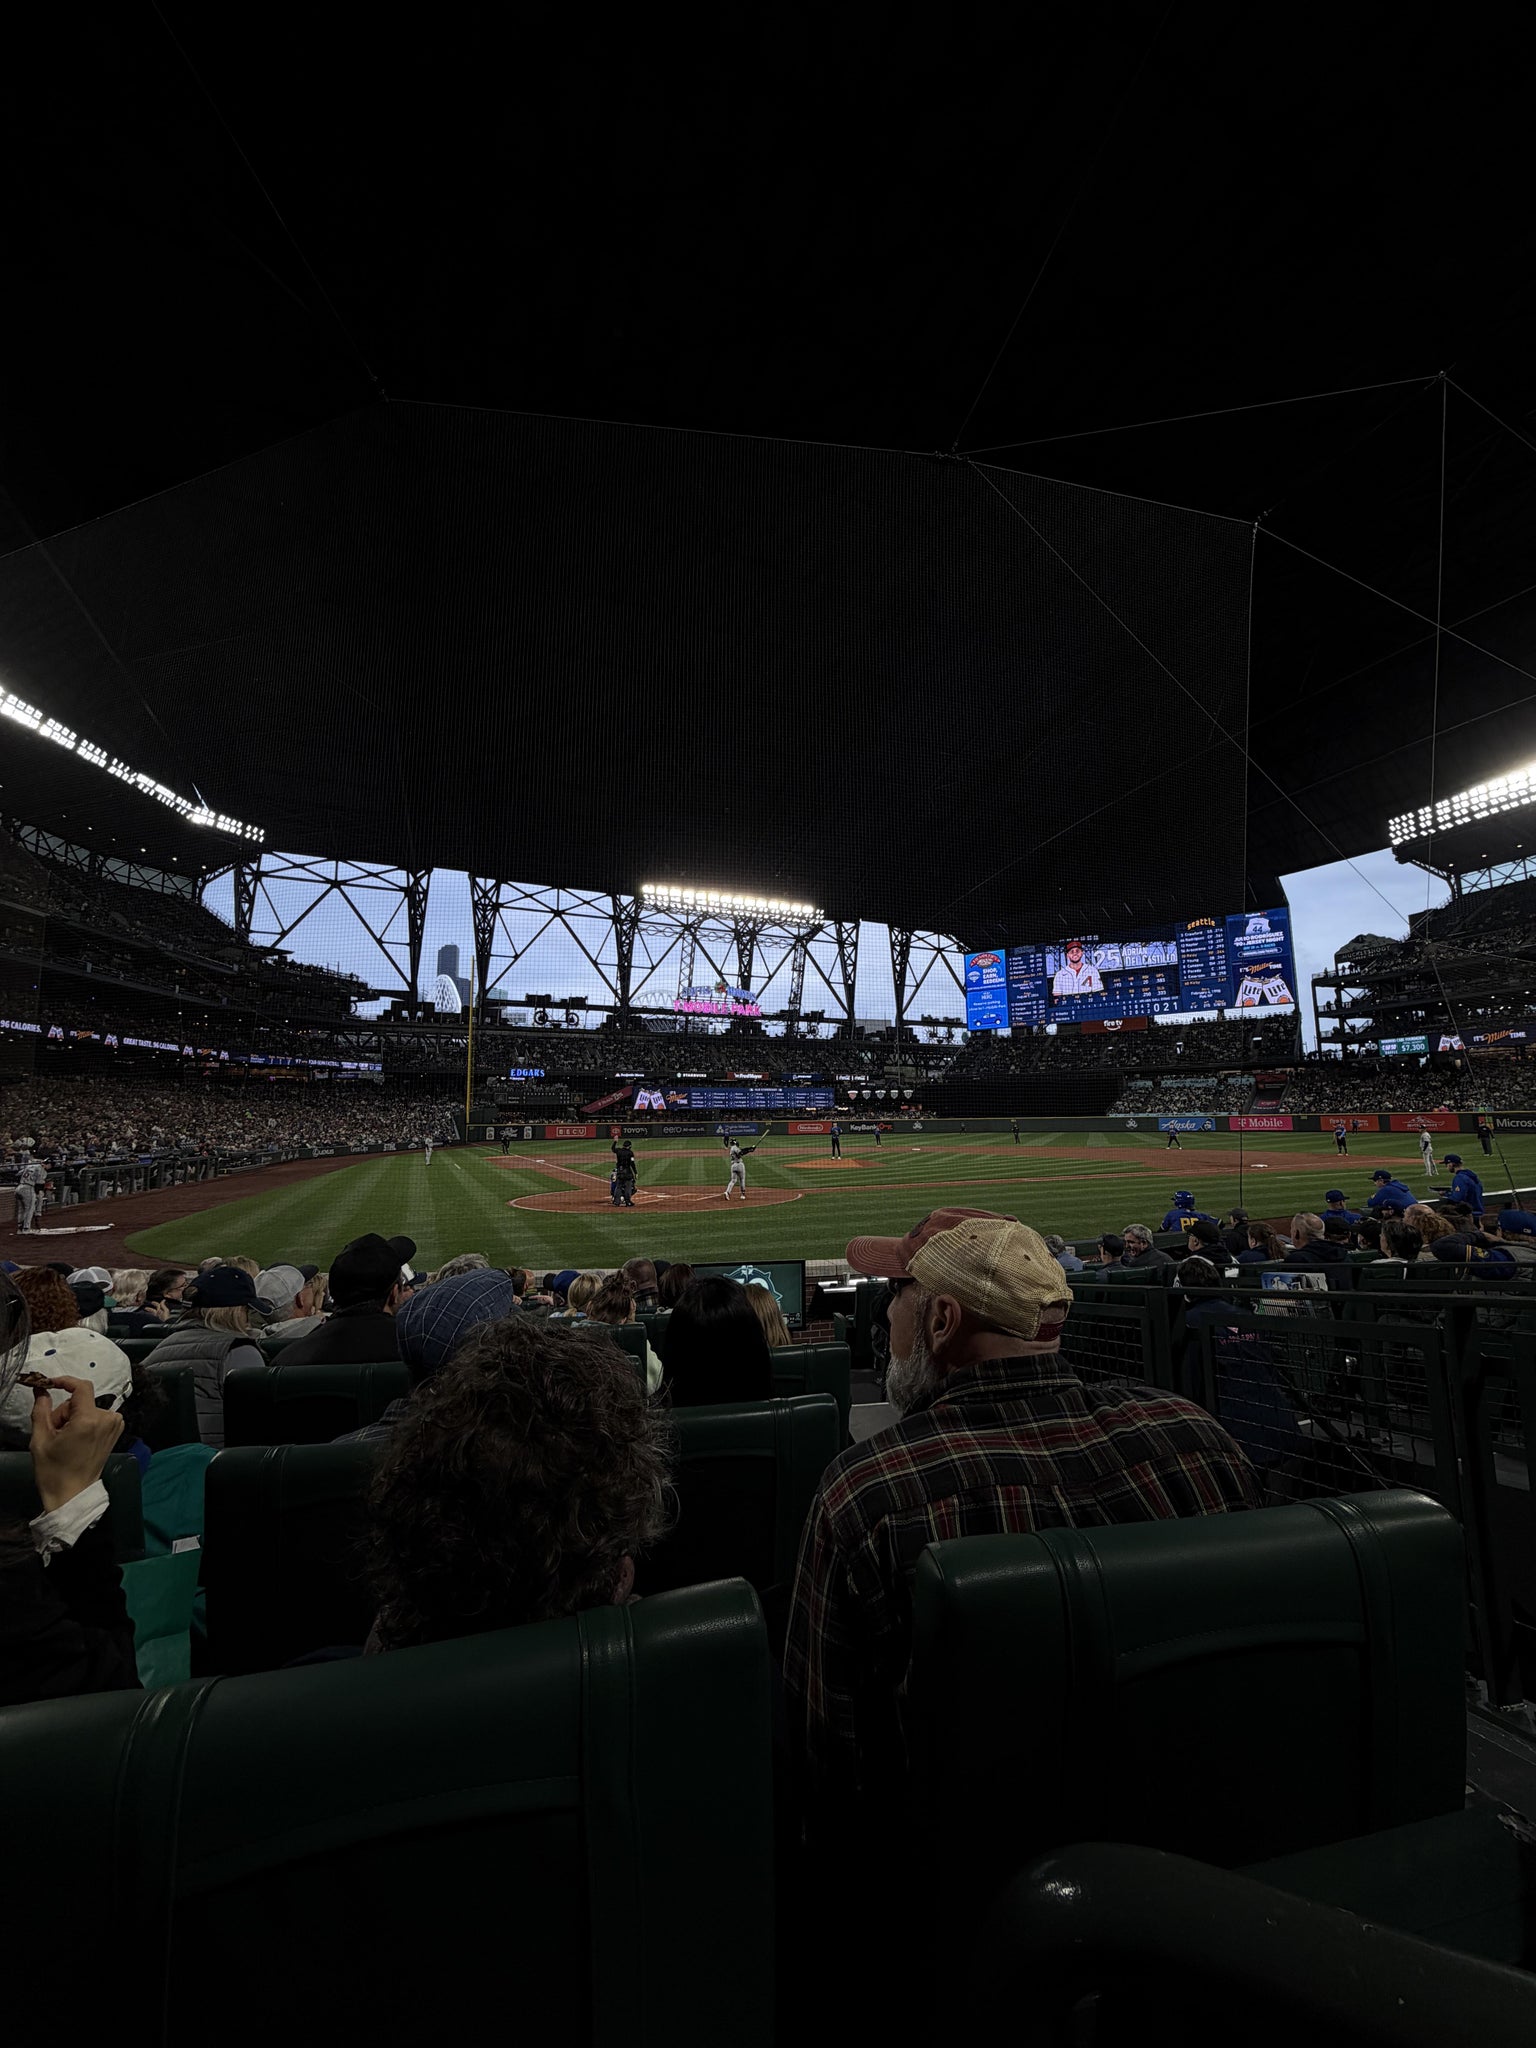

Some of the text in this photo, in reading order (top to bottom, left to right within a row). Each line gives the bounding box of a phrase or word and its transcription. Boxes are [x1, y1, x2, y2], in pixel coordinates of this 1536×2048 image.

[1187, 917, 1216, 930] seattle
[1121, 947, 1148, 957] ADRIAN
[1093, 950, 1120, 969] 25
[1125, 953, 1178, 966] DEL CASTILLO
[1248, 962, 1273, 974] Miller
[1244, 985, 1260, 996] Lite
[1268, 983, 1286, 997] Lite
[673, 999, 762, 1016] T-MOBILE PARK
[1153, 1002, 1178, 1012] 0 2 1
[0, 1020, 42, 1033] 96 CALORIES.
[1483, 1029, 1516, 1044] Miller
[1510, 1031, 1527, 1039] TIME
[123, 1037, 138, 1046] GREAT
[138, 1040, 152, 1048] TASTE.
[159, 1042, 180, 1052] CALORIES.
[1161, 1119, 1196, 1130] Alaska
[1248, 1118, 1283, 1128] Mobile
[559, 1128, 585, 1136] BECU
